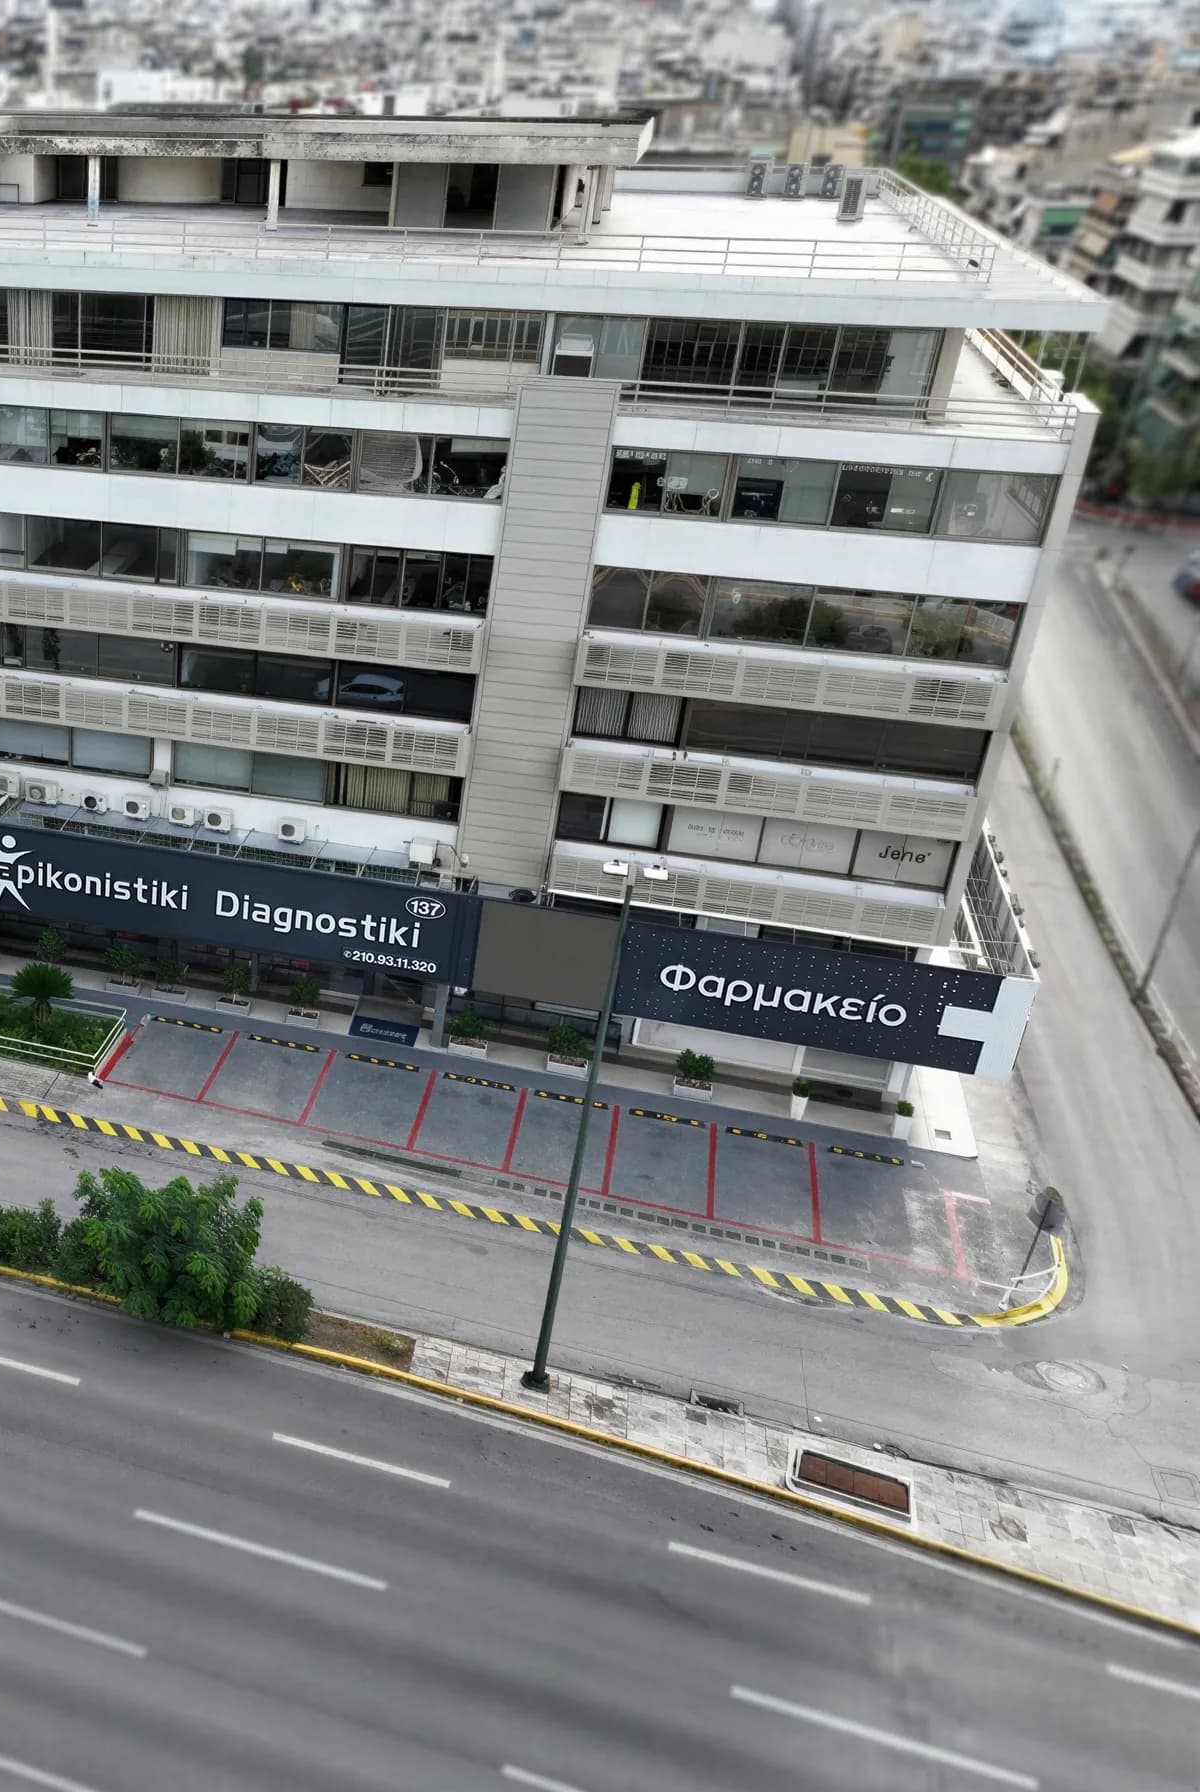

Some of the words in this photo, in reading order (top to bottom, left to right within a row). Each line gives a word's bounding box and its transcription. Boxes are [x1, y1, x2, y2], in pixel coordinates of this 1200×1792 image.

[216, 890, 421, 948] Diagnostiki
[411, 900, 441, 916] 137
[352, 950, 437, 974] 210.93.11.320
[660, 964, 907, 1027] Φαρμακείο
